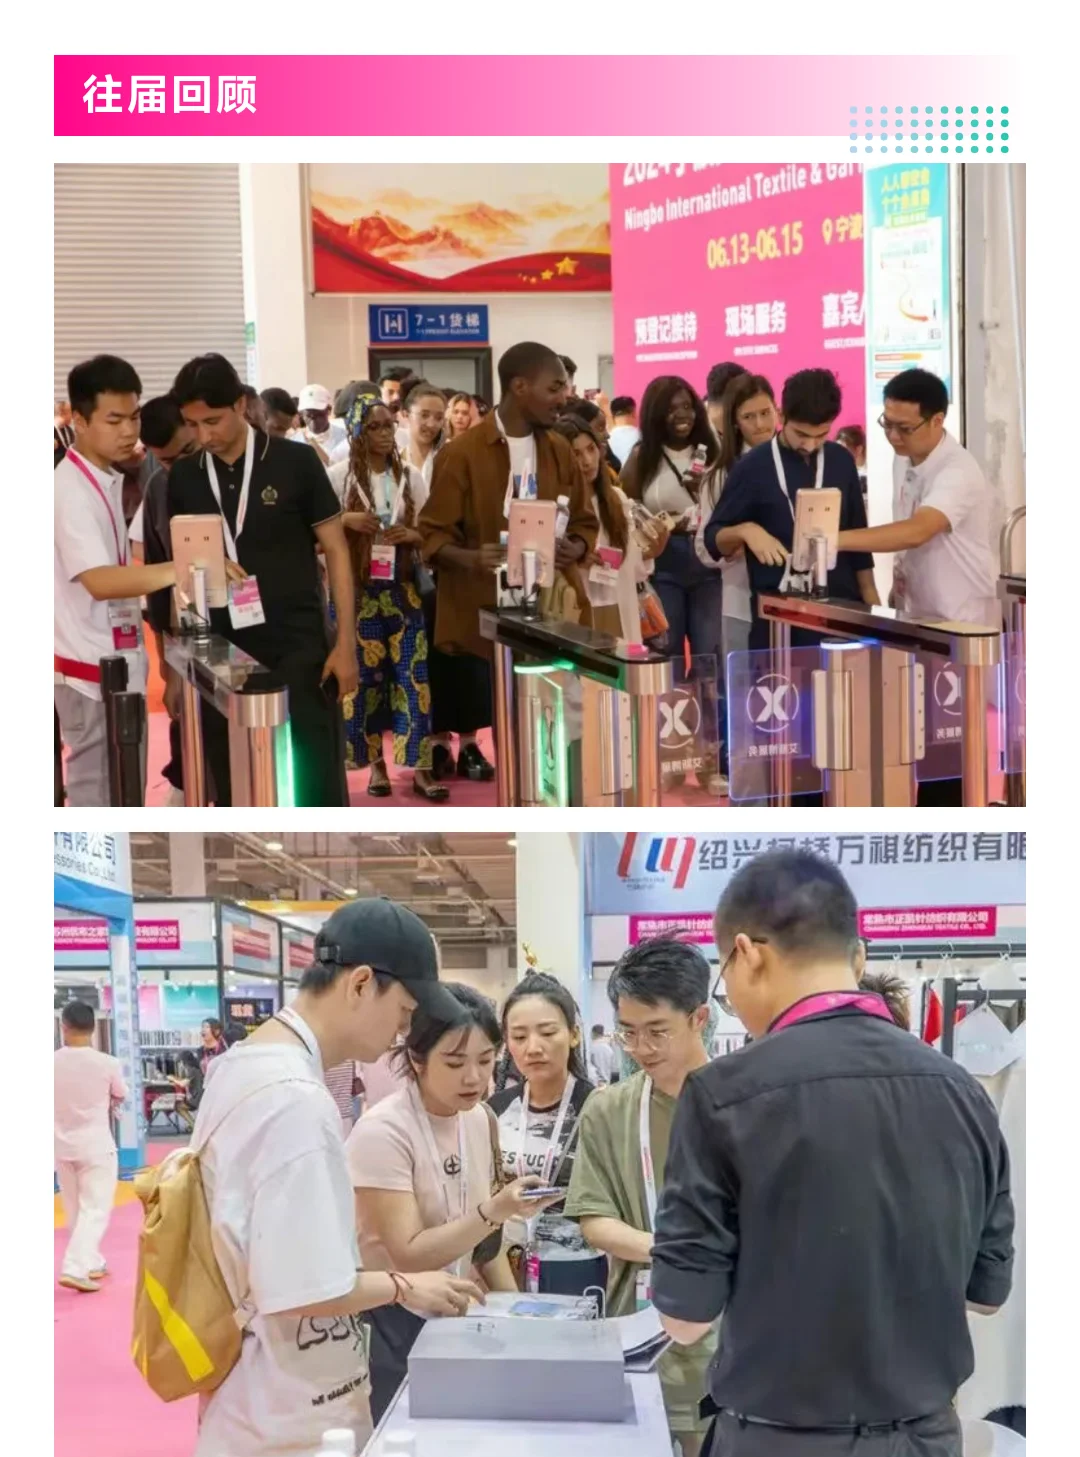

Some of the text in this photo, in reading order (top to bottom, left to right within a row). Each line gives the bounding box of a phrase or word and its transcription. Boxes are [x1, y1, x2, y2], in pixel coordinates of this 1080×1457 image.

[624, 202, 665, 232] Ningbo
[666, 176, 752, 222] International
[754, 167, 807, 199] Textile
[810, 164, 822, 186] &
[707, 220, 804, 270] 06.13-06.15
[635, 312, 697, 346] 预登记接待
[725, 300, 787, 337] 现场服务
